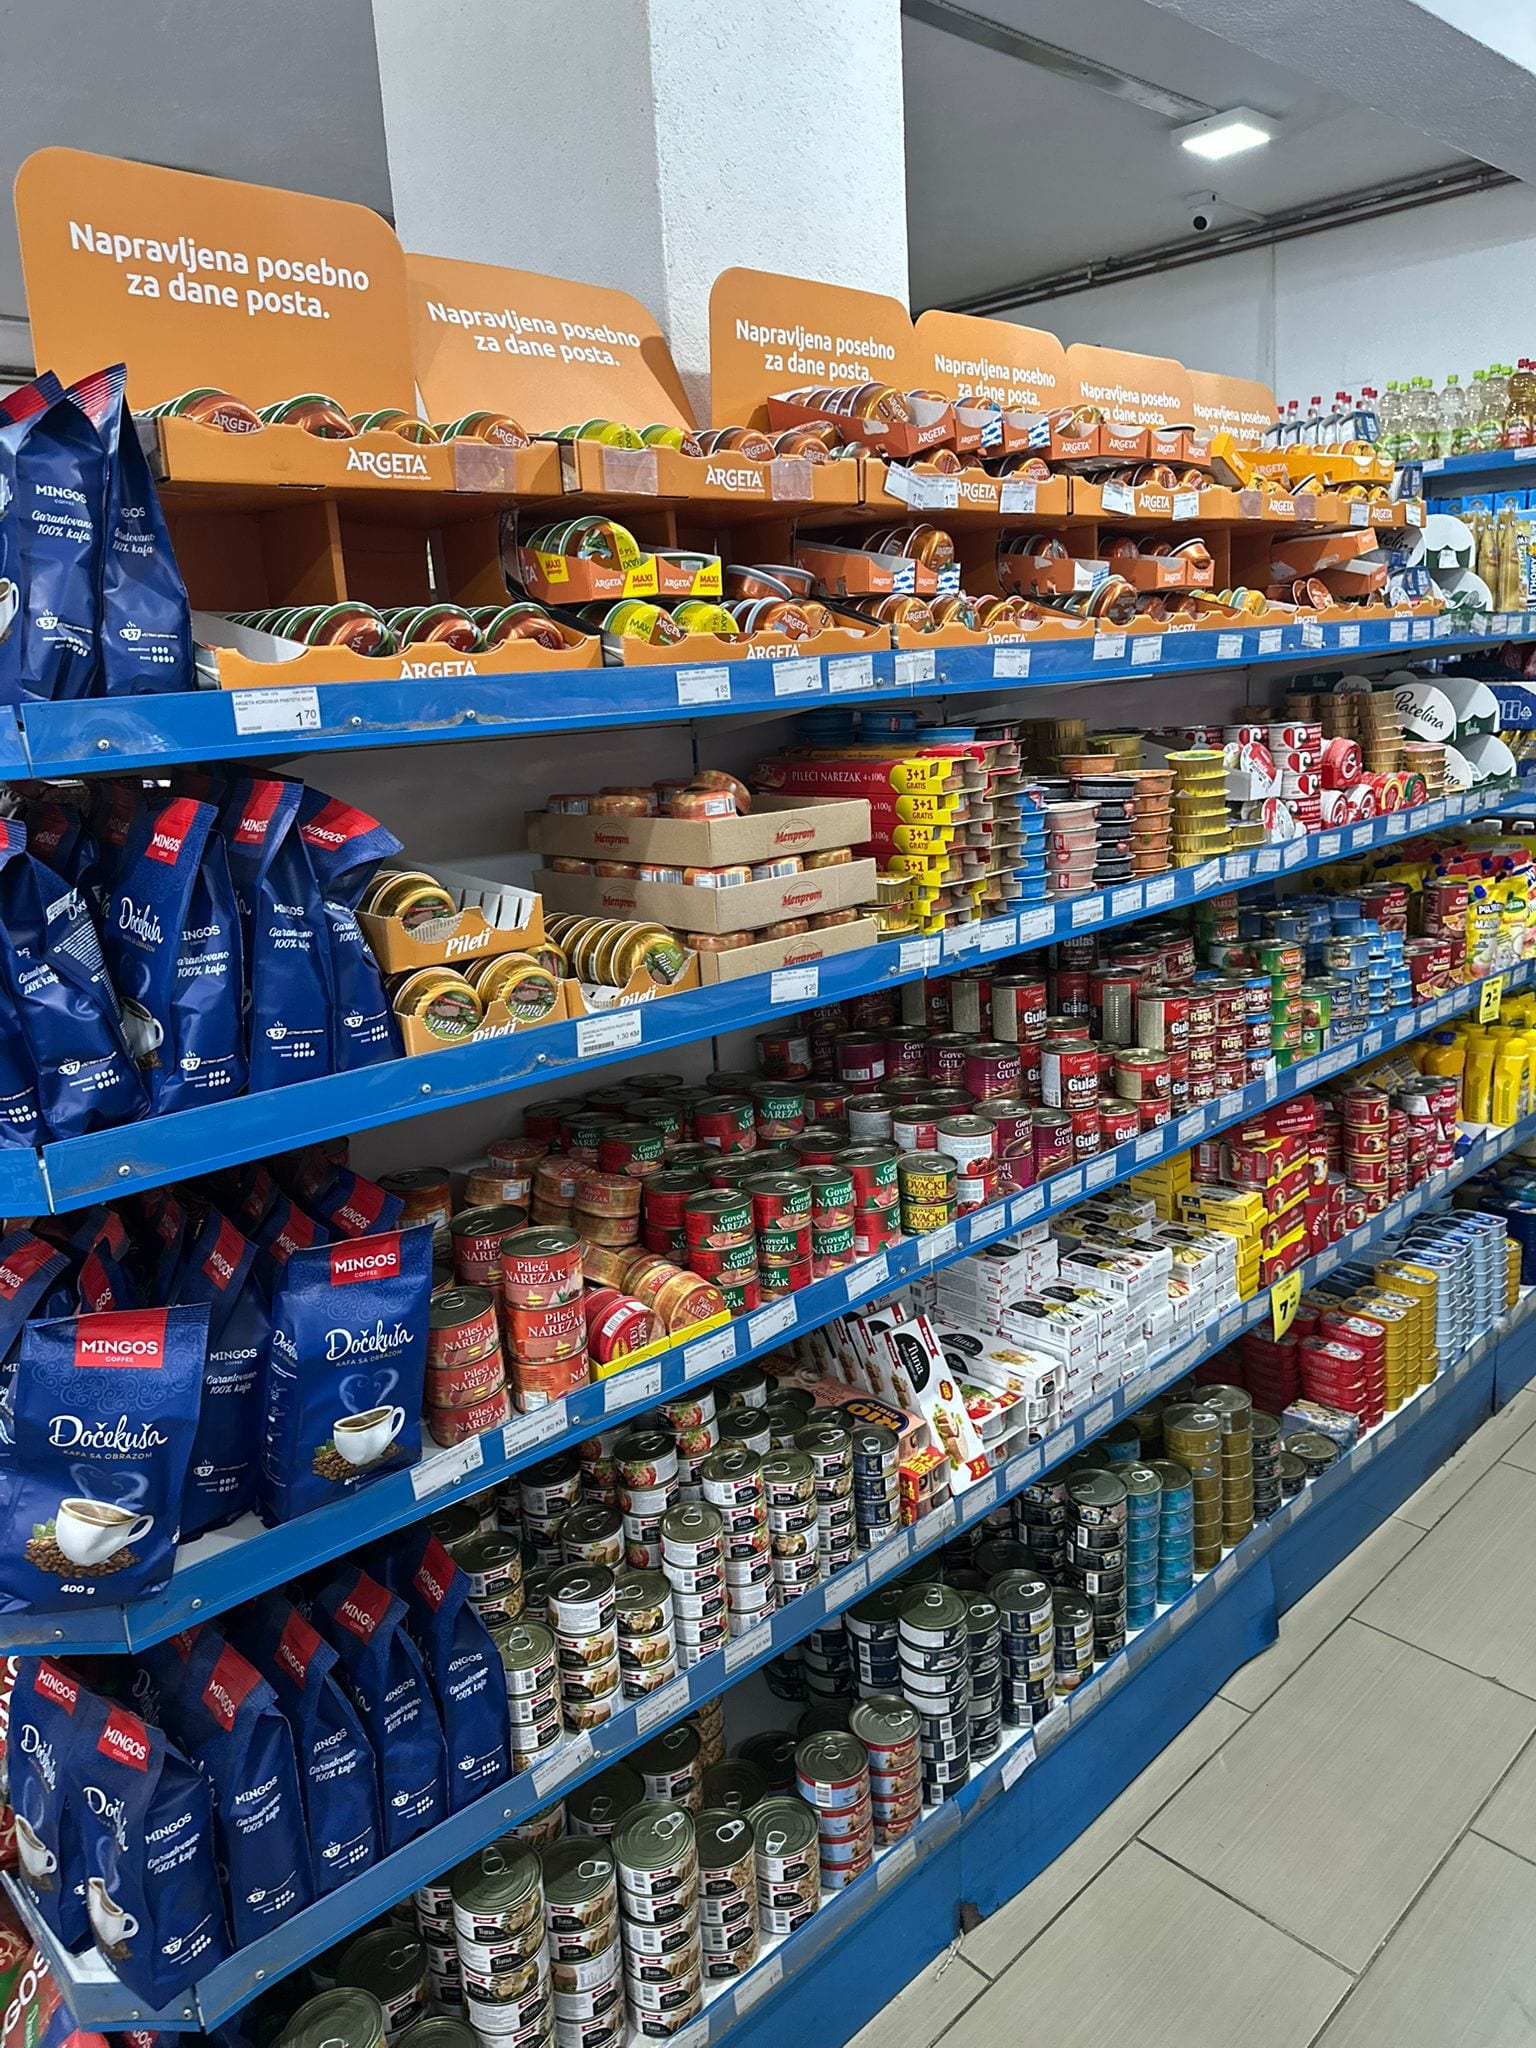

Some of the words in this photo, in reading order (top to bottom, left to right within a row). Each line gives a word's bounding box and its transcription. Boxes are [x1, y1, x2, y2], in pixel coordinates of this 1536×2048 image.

[69, 220, 249, 275] Napravljena
[257, 258, 369, 292] posebno
[127, 272, 160, 299] za
[169, 276, 238, 308] dane
[247, 288, 330, 320] posta.
[426, 301, 557, 337] Napravljena
[562, 321, 641, 350] posebno
[735, 319, 832, 353] Napravljena
[835, 337, 895, 361] posebno
[473, 335, 500, 353] za
[504, 335, 556, 359] dane
[562, 342, 621, 367] posta.
[764, 352, 785, 372] za
[787, 351, 825, 378] dane
[829, 359, 874, 384] posta.
[934, 353, 1010, 382] Napravljena
[1011, 364, 1056, 390] posebno
[957, 382, 974, 398] za
[974, 381, 1008, 404] dane
[1007, 386, 1041, 407] posta.
[1080, 381, 1140, 407] Napravljena
[1141, 391, 1181, 409] posebno
[1111, 405, 1137, 423] dane
[1138, 407, 1168, 427] posta.
[1193, 402, 1241, 425] Napravljena
[1241, 408, 1272, 426] posebno
[917, 426, 947, 443] ARGETA
[1061, 441, 1092, 452] ARGETA
[1109, 438, 1140, 455] ARGETA
[346, 450, 427, 479] ARGETA
[1254, 464, 1288, 475] ARGETA
[705, 465, 763, 491] ARGETA
[35, 484, 87, 504] MINGOS
[956, 478, 998, 503] ARGETA
[54, 499, 75, 507] COFFEE
[1138, 492, 1171, 510] ARGETA
[1268, 498, 1295, 513] ARGETA
[32, 510, 93, 530] Garantovano
[1371, 507, 1393, 520] ARGETA
[37, 524, 64, 537] 100%
[66, 529, 91, 543] kafa
[545, 560, 561, 570] MAXI
[595, 577, 622, 590] ARGETA
[632, 574, 653, 583] MAXI
[664, 578, 691, 588] ARGETA
[700, 575, 719, 584] MAXI
[43, 619, 55, 627] 57
[629, 618, 652, 635] MAXI
[128, 630, 139, 638] 57
[986, 633, 1027, 645] ARGETA
[746, 644, 799, 660] ARGETA
[400, 660, 478, 679] ARGETA
[1394, 690, 1445, 730] Patelina
[792, 771, 819, 782] PILEĆI
[821, 771, 861, 782] NAREZAK
[905, 769, 926, 783] 3+1
[906, 783, 927, 792] GRATIS
[240, 818, 269, 832] MINGOS
[151, 832, 180, 852] MINGOS
[302, 824, 347, 849] MINGOS
[775, 827, 816, 844] Menprom
[782, 890, 822, 907] Menprom
[445, 928, 492, 958] Pileti
[177, 964, 202, 978] 100%
[205, 963, 227, 976] kafa
[654, 951, 676, 977] Pileti
[620, 985, 657, 1007] Pileti
[1190, 1011, 1213, 1023] Ragu
[274, 1029, 284, 1038] 57
[472, 1018, 518, 1043] Pileti
[1221, 1038, 1243, 1050] Ragu
[187, 1059, 198, 1068] 57
[1190, 1050, 1213, 1061] Ragu
[66, 1064, 78, 1073] 57
[1068, 1075, 1098, 1091] Gulaš
[1193, 1085, 1214, 1096] Ragu
[768, 1101, 798, 1110] Govedi
[790, 1192, 811, 1206] Govedi
[825, 1185, 853, 1197] Govedi
[339, 1205, 370, 1230] MINGOS
[712, 1218, 752, 1233] NAREZAK
[719, 1211, 747, 1224] Govedi
[759, 1237, 789, 1245] Govedi
[818, 1233, 850, 1245] Govedi
[730, 1247, 754, 1261] Govedi
[210, 1250, 234, 1280] MINGOS
[334, 1252, 397, 1274] MINGOS
[517, 1261, 549, 1272] Pileći
[354, 1270, 378, 1278] COFFEE
[506, 1268, 567, 1284] NAREZAK
[544, 1308, 575, 1325] Pileći
[457, 1323, 484, 1339] Pileći
[528, 1314, 584, 1339] NAREZAK
[325, 1319, 414, 1361] Dočekuša
[444, 1326, 494, 1351] NAREZAK
[81, 1341, 159, 1355] MINGOS
[210, 1349, 257, 1361] MINGOS
[336, 1357, 357, 1368] KAFA
[358, 1356, 368, 1364] SA
[370, 1349, 403, 1362] OBRAZOM
[206, 1371, 257, 1385] Garantovano
[450, 1369, 500, 1393] NAREZAK
[463, 1367, 490, 1379] Pileći
[210, 1384, 232, 1395] 100%
[234, 1382, 252, 1394] kafa
[455, 1406, 505, 1433] NAREZAK
[468, 1403, 494, 1420] Pileći
[49, 1414, 169, 1453] Dočekuša
[63, 1449, 87, 1459] KAFA
[105, 1452, 152, 1460] OBRAZOM
[60, 1584, 85, 1594] 400
[87, 1586, 95, 1595] g
[418, 1566, 445, 1601] MINGOS
[279, 1642, 306, 1679] MINGOS
[38, 1668, 77, 1703] MINGOS
[208, 1679, 235, 1718] MINGOS
[103, 1726, 147, 1761] MINGOS
[235, 1776, 278, 1805] MINGOS
[145, 1812, 192, 1842] MINGOS
